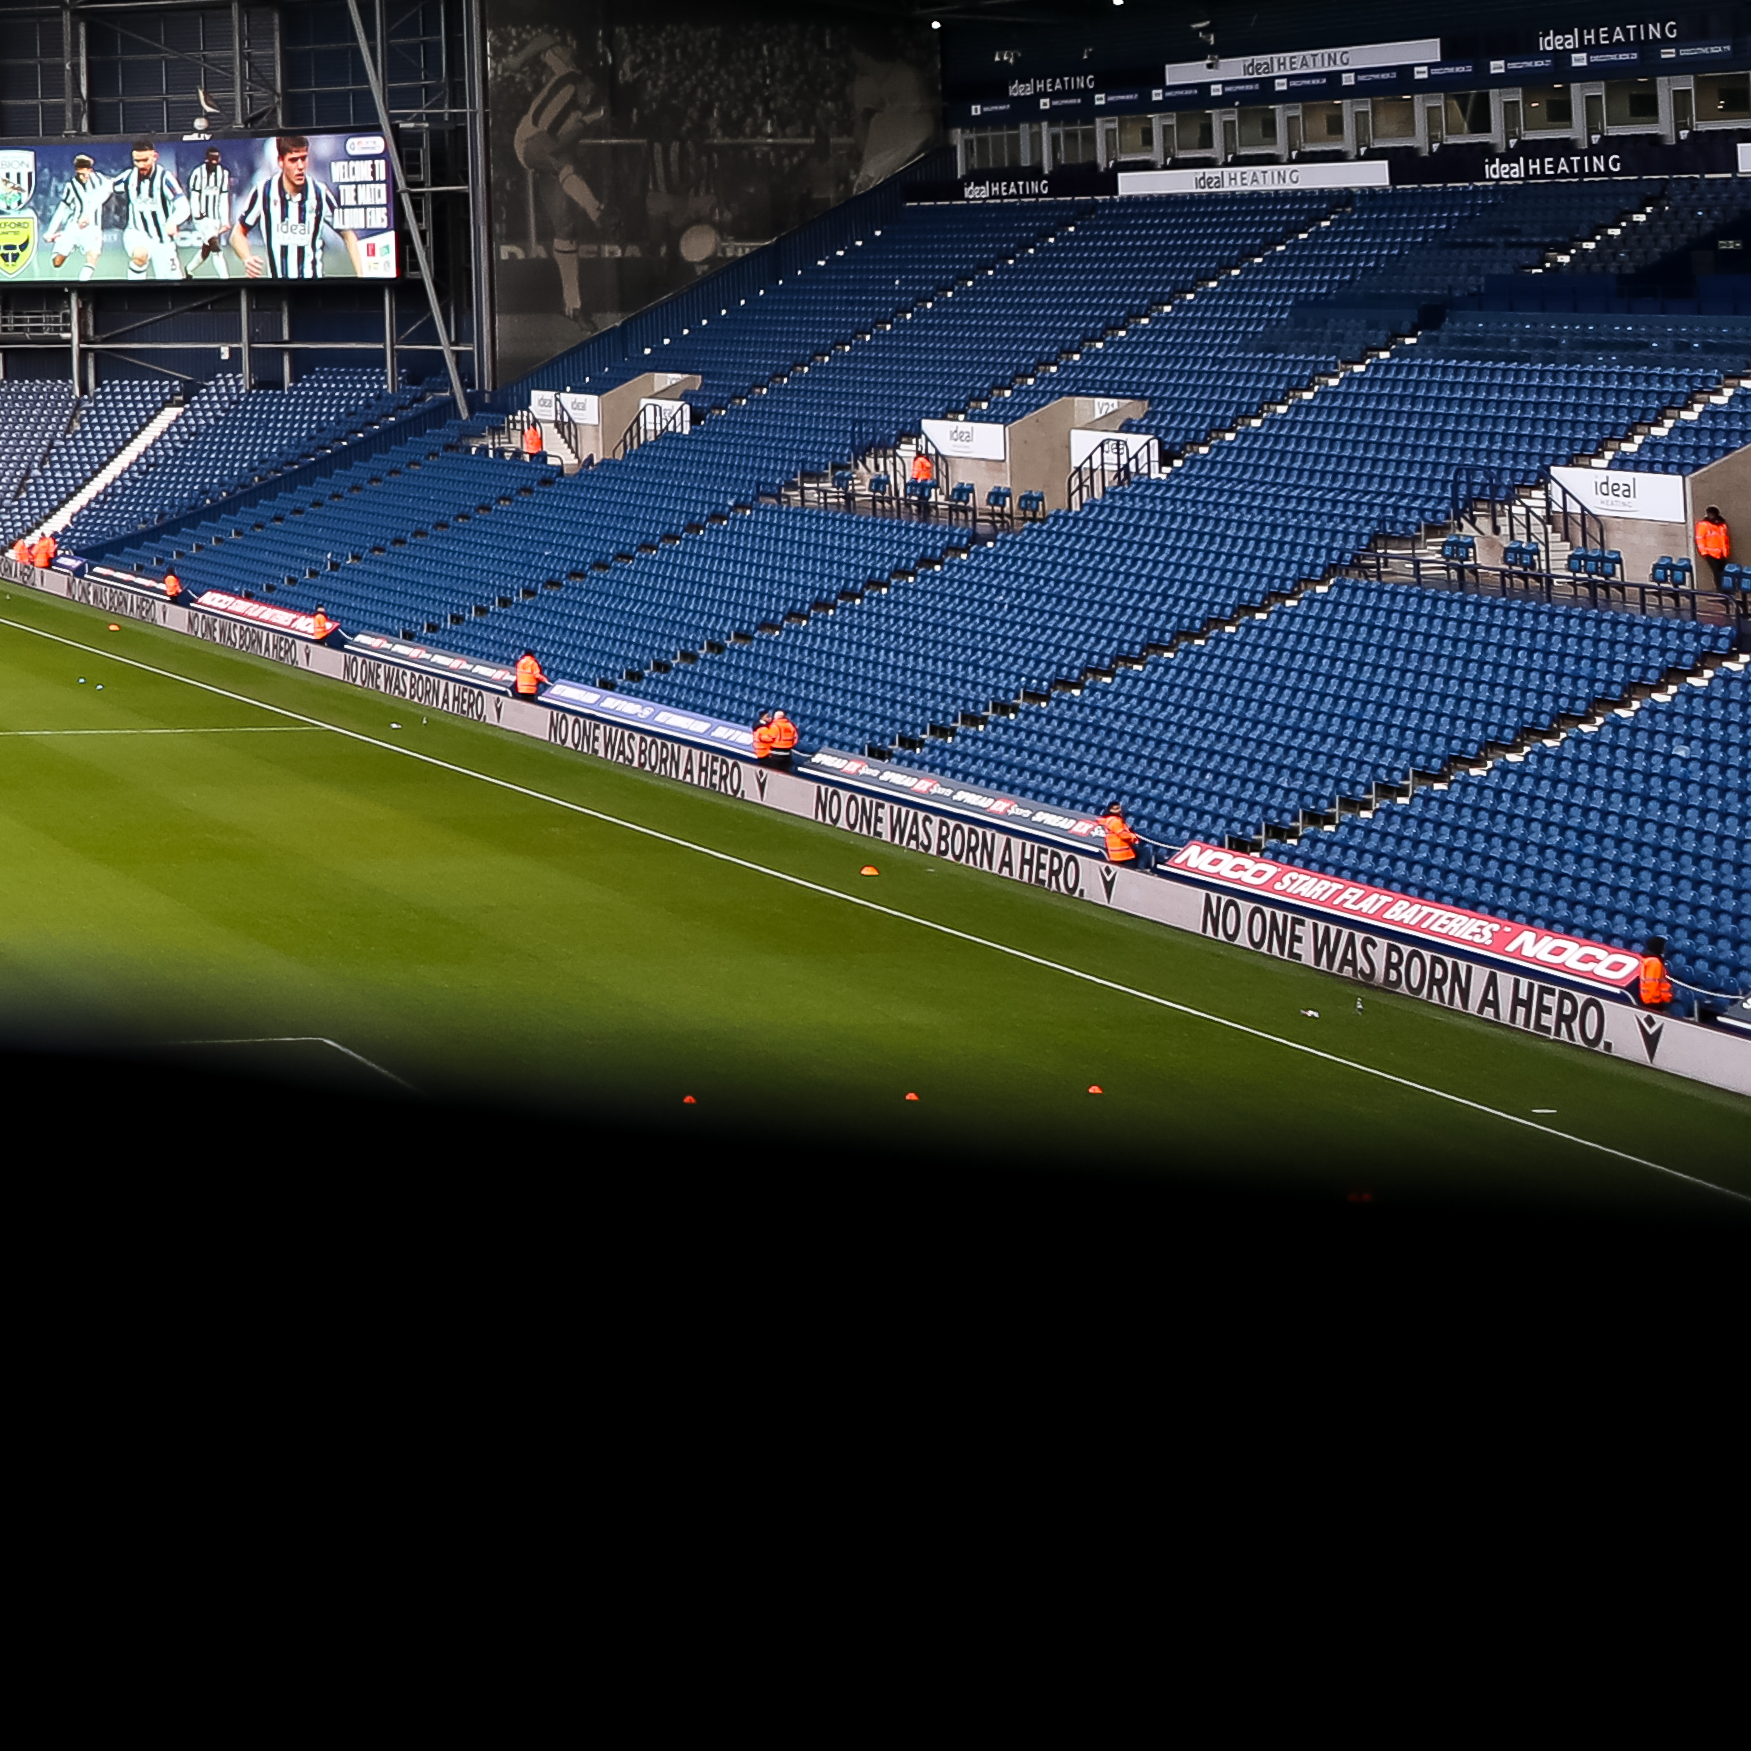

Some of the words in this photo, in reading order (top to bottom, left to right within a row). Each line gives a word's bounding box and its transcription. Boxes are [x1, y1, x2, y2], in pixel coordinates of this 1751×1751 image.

[1539, 28, 1578, 51] ideal
[1583, 21, 1677, 46] HEATING
[1243, 57, 1276, 77] ideal
[1278, 51, 1350, 71] HEATING
[1008, 78, 1035, 97] ideal
[1036, 75, 1095, 94] HEATING
[1194, 171, 1225, 190] ideal
[1228, 168, 1299, 187] HEATING
[1484, 157, 1524, 180] ideal
[1528, 154, 1621, 176] HEATING
[964, 181, 990, 199] ideal
[992, 180, 1049, 197] HEATING
[277, 219, 310, 235] ideal
[1594, 476, 1637, 499] ideal
[187, 611, 199, 637] NO
[200, 615, 217, 642] ONE
[218, 619, 238, 650] WAS
[238, 627, 263, 657] BORN
[263, 633, 271, 658] A
[343, 654, 359, 683] NO
[360, 659, 381, 691] ONE
[383, 665, 408, 699] WAS
[408, 674, 438, 708] BORN
[441, 682, 450, 711] A
[451, 684, 487, 723] HERO.
[548, 710, 569, 745] NO
[571, 717, 600, 755] ONE
[603, 725, 636, 766] WAS
[638, 737, 679, 780] BORN
[683, 750, 695, 785] A
[697, 752, 746, 799] HERO.
[814, 785, 840, 826] NO
[846, 794, 885, 839] ONE
[887, 804, 933, 858] WAS
[937, 819, 998, 873] BORN
[998, 837, 1014, 876] A
[1019, 842, 1085, 898] HERO.
[1175, 845, 1278, 886] NOCO
[1274, 871, 1341, 902] START
[1332, 888, 1395, 916] FLAT
[1382, 900, 1501, 946] BATTERIES.
[1505, 930, 1639, 980] NOCO
[1200, 892, 1241, 942] NO
[1248, 905, 1306, 962] ONE
[1311, 921, 1378, 984] WAS
[1384, 941, 1472, 1011] BORN
[1477, 969, 1501, 1021] A
[1509, 976, 1613, 1053] HERO.
